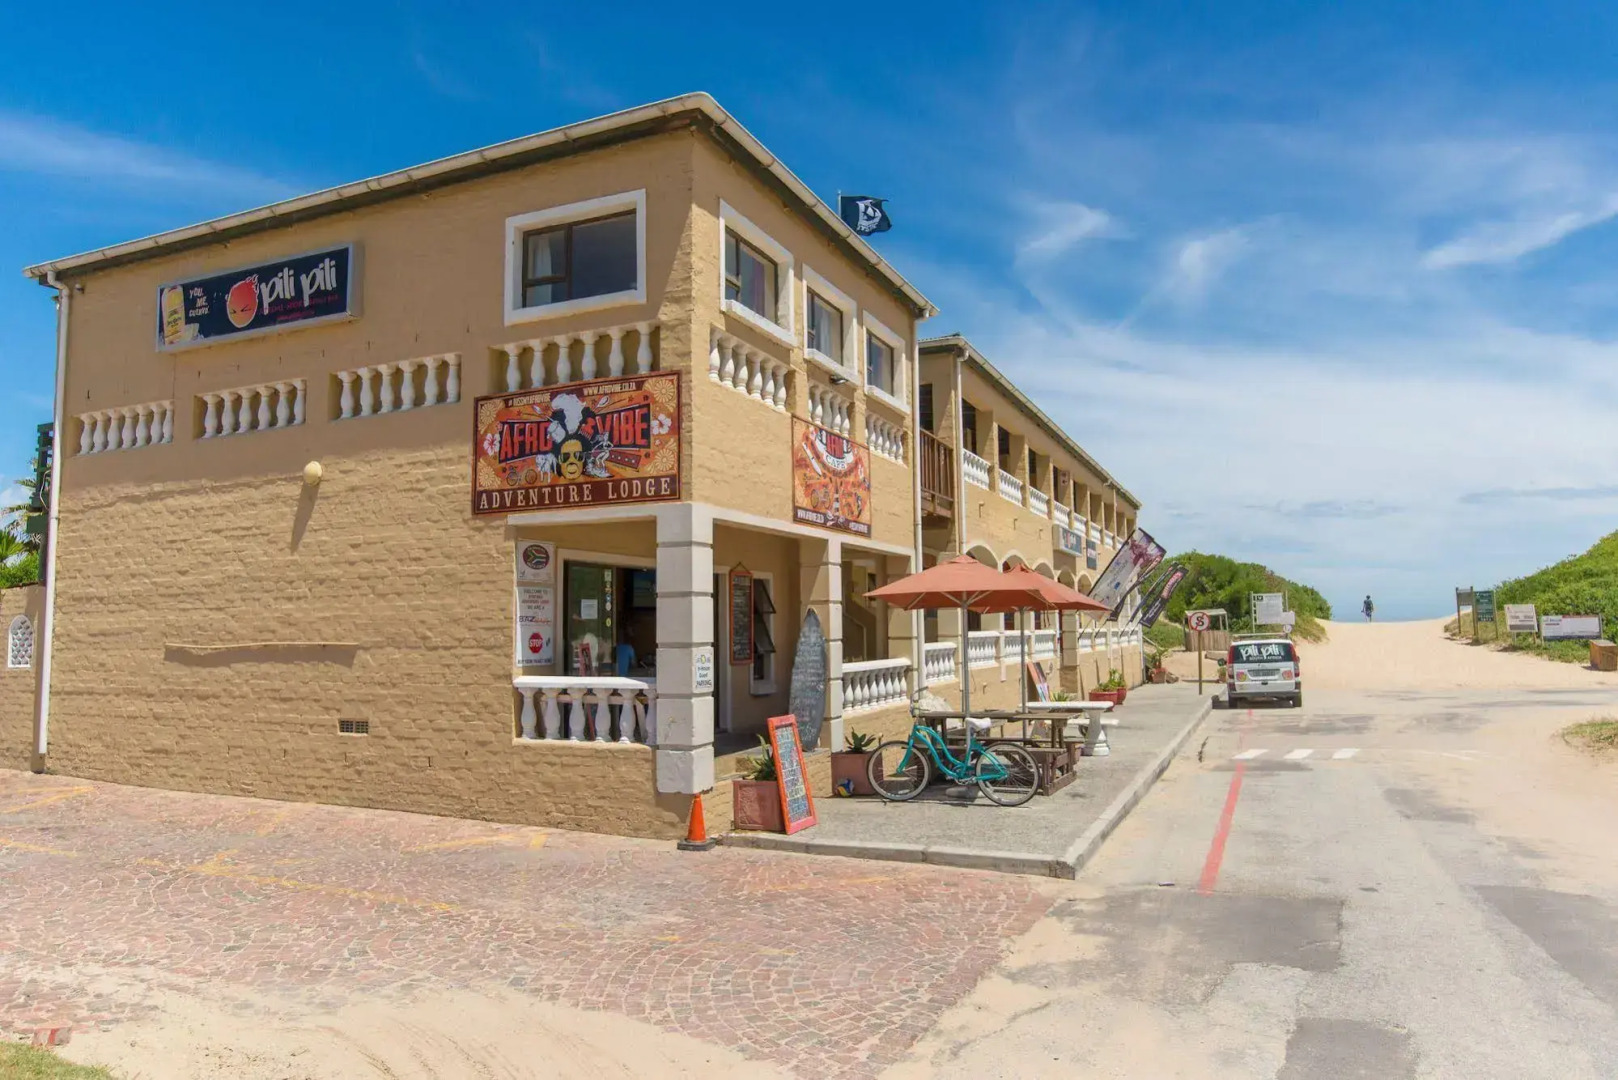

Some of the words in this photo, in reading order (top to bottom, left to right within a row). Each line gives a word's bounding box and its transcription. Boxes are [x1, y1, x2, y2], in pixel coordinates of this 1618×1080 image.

[260, 267, 295, 316] pili
[300, 258, 337, 307] pili
[500, 422, 552, 459] AFRO
[596, 407, 648, 446] VIBE
[825, 455, 846, 469] CAFE
[480, 484, 592, 510] ADVENTURE
[608, 477, 671, 500] LODGE
[1195, 616, 1205, 627] S
[529, 638, 543, 648] STOP
[1240, 644, 1259, 661] pili
[1260, 644, 1281, 660] pili
